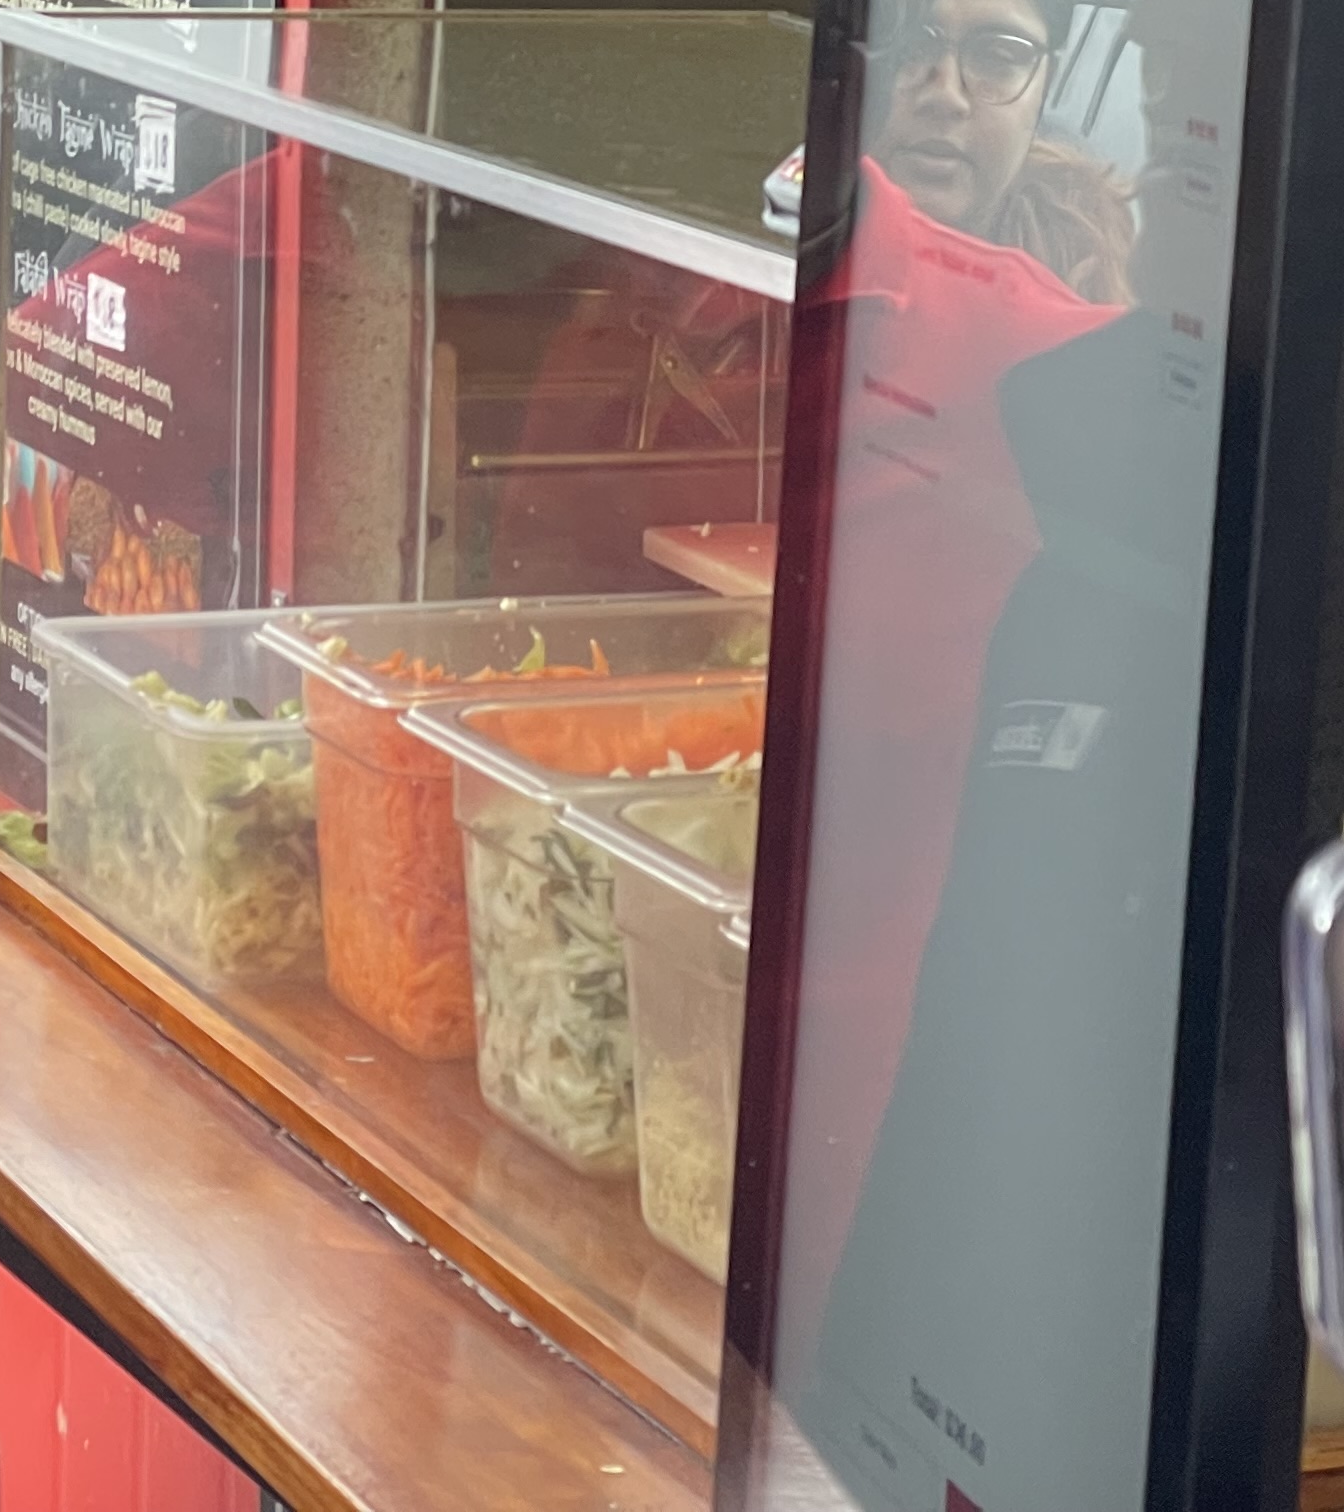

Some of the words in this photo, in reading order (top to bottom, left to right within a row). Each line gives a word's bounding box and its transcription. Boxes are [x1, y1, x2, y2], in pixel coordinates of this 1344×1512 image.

[13, 87, 53, 140] hicken
[57, 99, 98, 157] Tagine
[100, 118, 136, 175] Wrap
[56, 166, 87, 198] chicken
[87, 182, 131, 214] marinated
[141, 197, 185, 234] Moroccan
[69, 213, 100, 240] cooked
[128, 232, 157, 264] tagine
[158, 246, 180, 275] style
[52, 266, 87, 324] Wrap
[43, 324, 77, 362] blended
[77, 342, 95, 370] with
[95, 354, 141, 391] preserved
[23, 352, 64, 392] Moroccan
[94, 391, 125, 422] served
[125, 402, 147, 432] with
[147, 415, 163, 440] our
[28, 395, 59, 432] creamy
[59, 404, 96, 446] hummus
